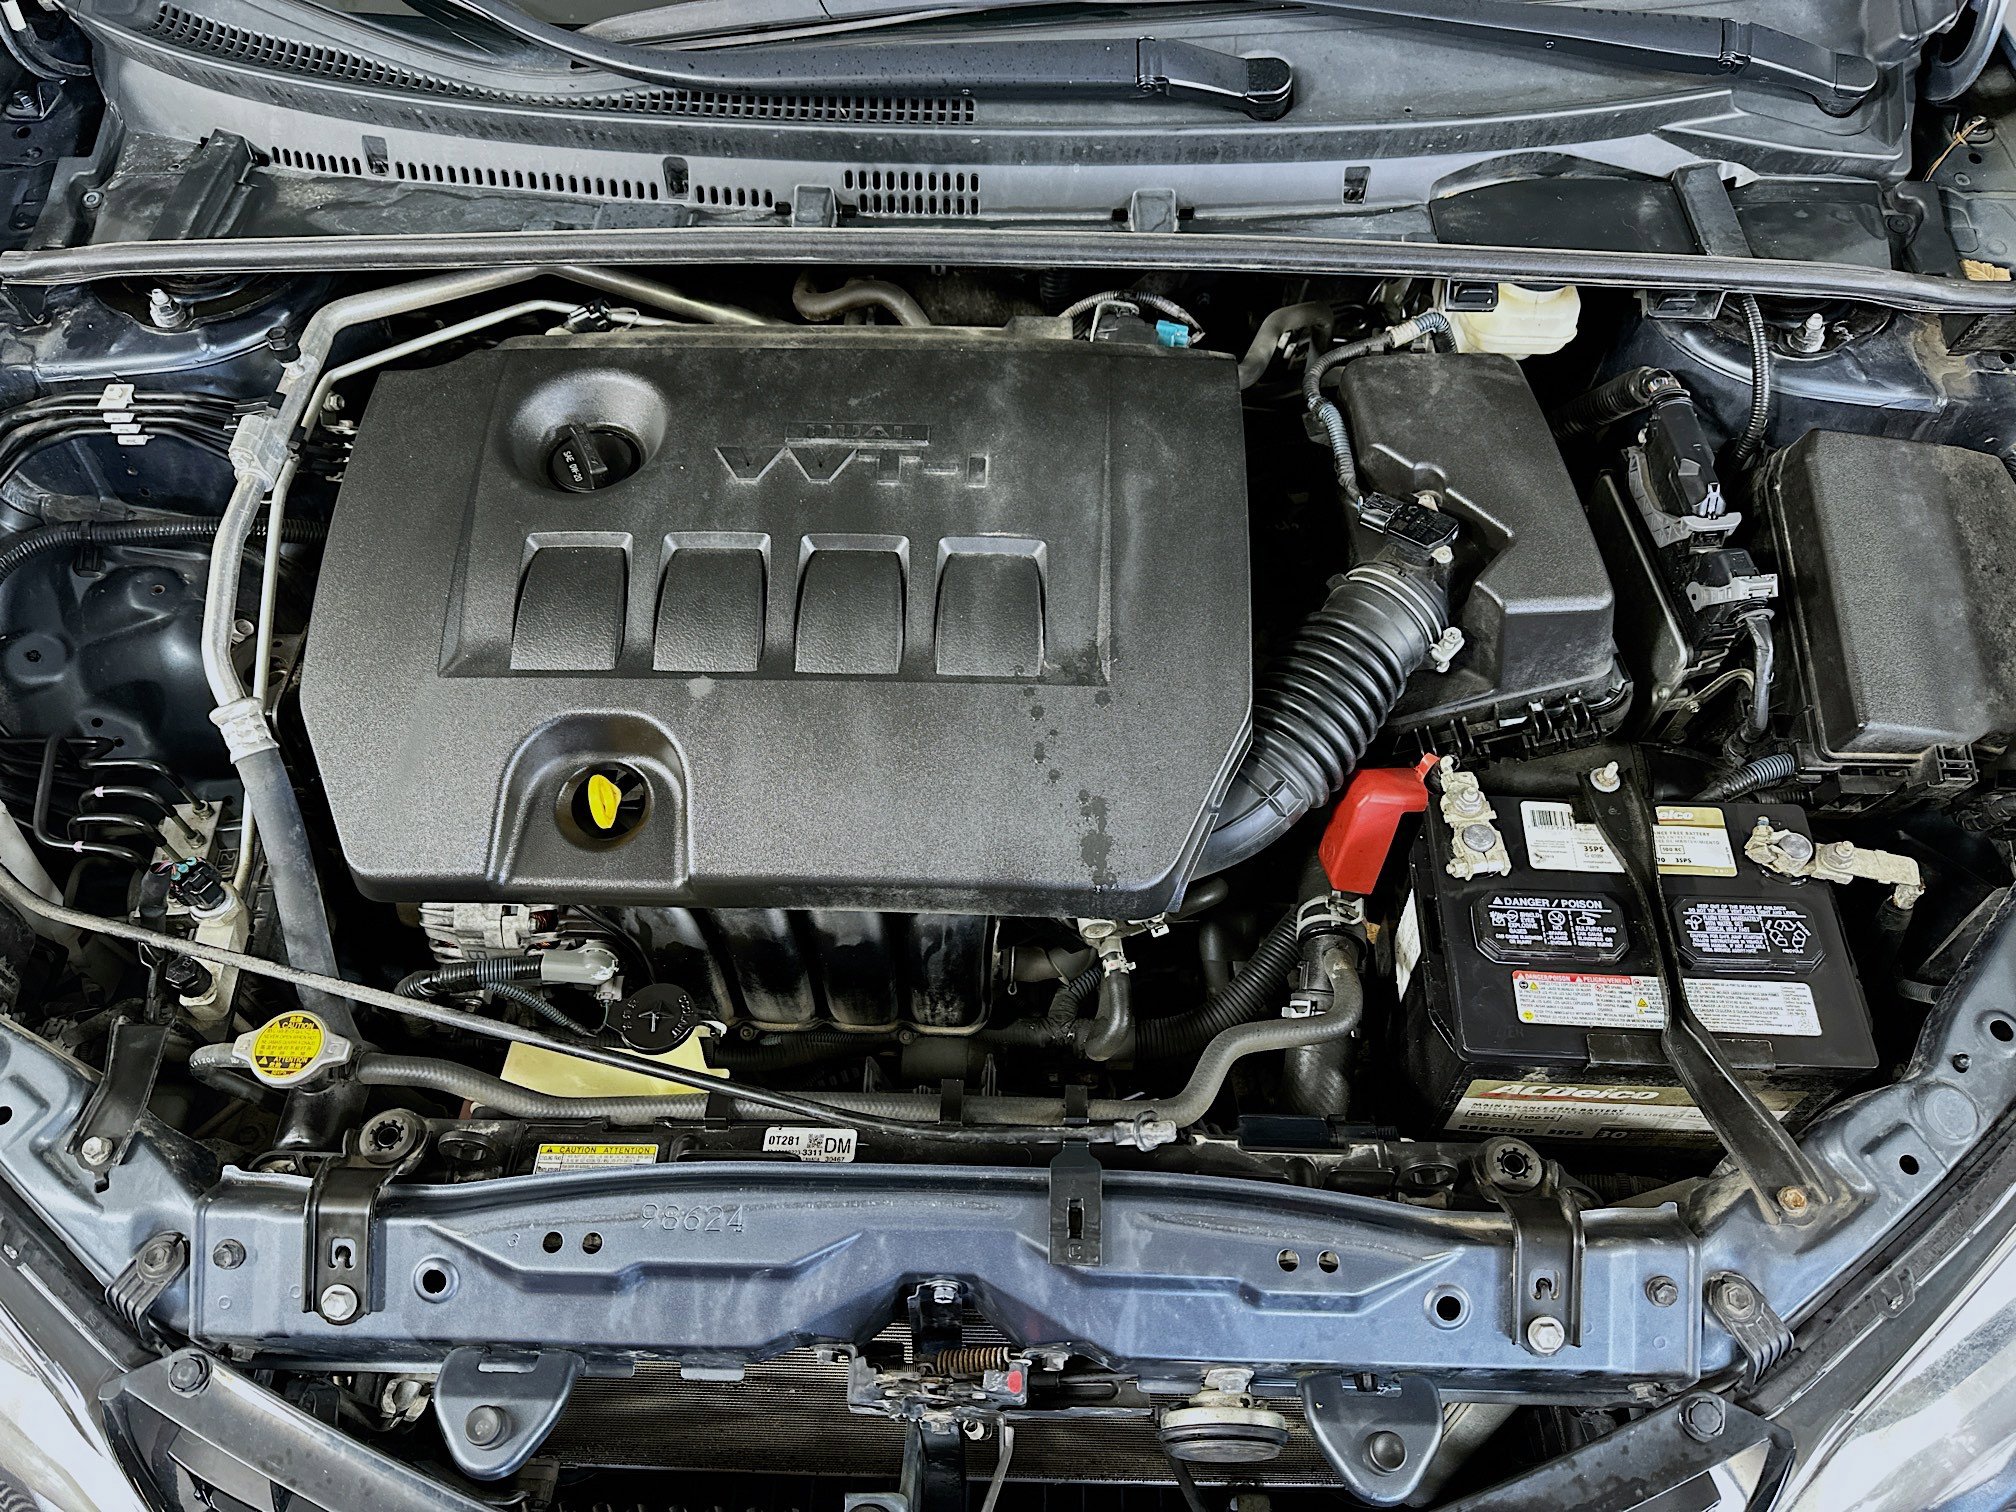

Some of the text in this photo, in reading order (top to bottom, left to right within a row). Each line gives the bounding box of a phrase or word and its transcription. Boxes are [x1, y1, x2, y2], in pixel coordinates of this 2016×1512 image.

[562, 450, 583, 482] SAE 0W-20
[1584, 845, 1604, 853] 35PS
[1504, 897, 1550, 907] DANGER
[1561, 899, 1603, 909] POISON
[282, 1021, 315, 1029] CAUTION
[1488, 1084, 1660, 1100] ACDelco
[1472, 1102, 1550, 1110] MAINTENANCE
[824, 1137, 851, 1154] DM
[641, 1203, 744, 1233] 98624
